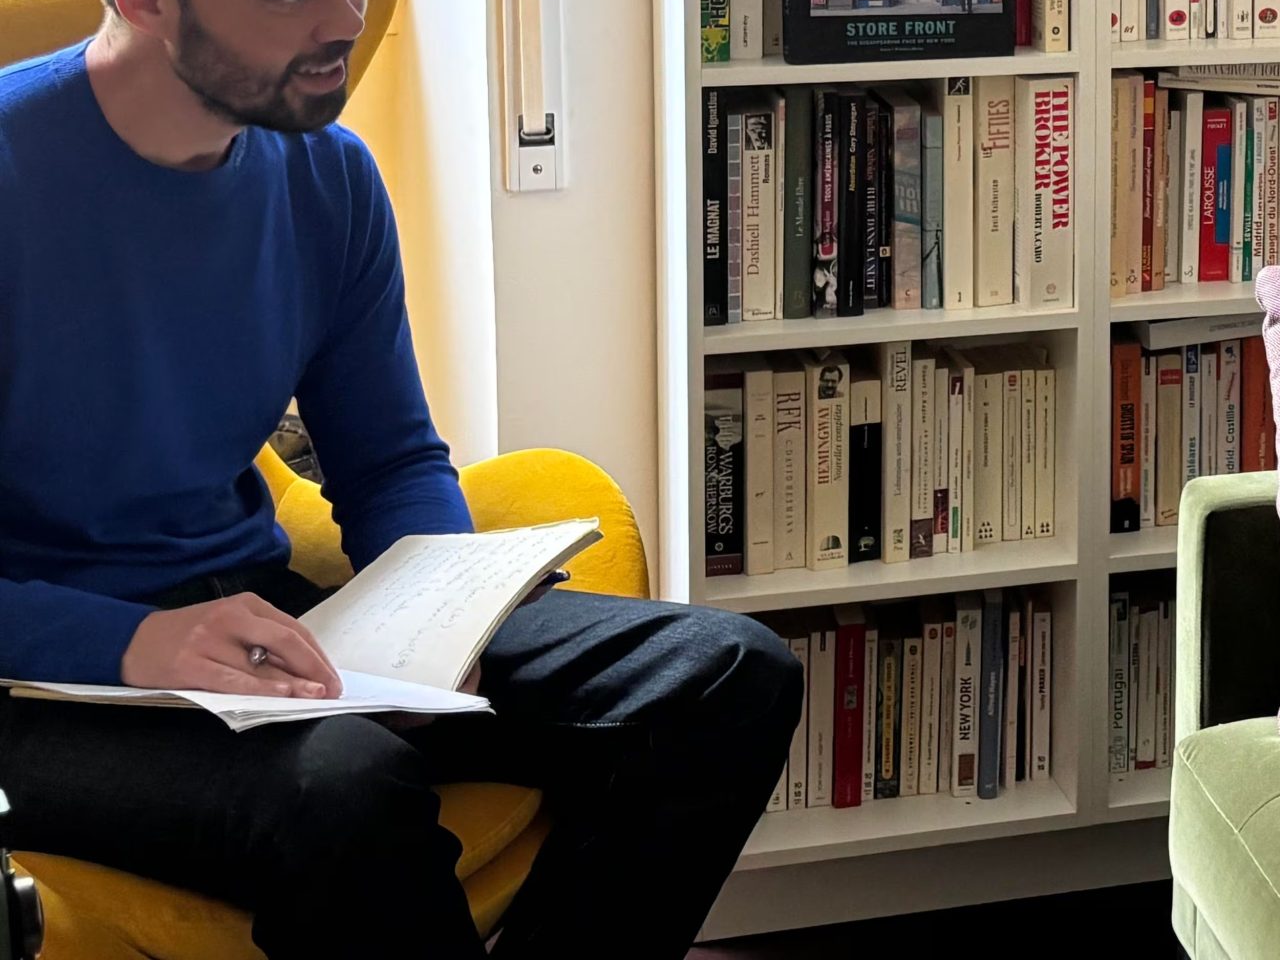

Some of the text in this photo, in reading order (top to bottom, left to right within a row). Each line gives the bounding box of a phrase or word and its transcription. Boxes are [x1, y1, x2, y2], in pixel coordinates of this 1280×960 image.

[846, 20, 956, 37] STORE FRONT
[706, 91, 719, 154] David Ignatius
[824, 113, 832, 132] PARIS
[980, 99, 1010, 151] FIFTIES
[1035, 90, 1052, 191] BROKER
[762, 154, 771, 184] Romans
[822, 140, 833, 182] AMÉRICAINES
[982, 147, 992, 159] LES
[1051, 84, 1070, 230] THE POWER
[745, 154, 760, 276] Dashiell Hammett
[824, 184, 832, 202] TROIS
[1203, 166, 1214, 225] LAROUSSE
[1267, 146, 1278, 266] Espagne du Nord-Ouest
[707, 198, 721, 259] LE MAGNAT
[1253, 221, 1263, 257] Madrid
[895, 346, 907, 393] REVEL
[776, 391, 801, 435] RFK
[833, 404, 844, 482] Nouvelles complètes
[818, 405, 831, 485] HEMINGWAY
[706, 446, 717, 534] RON CHERNOW
[718, 451, 733, 535] WARBURGS
[959, 676, 972, 741] NEW YORK
[987, 672, 996, 717] Alfred Hayes
[1110, 668, 1127, 730] Portugal
